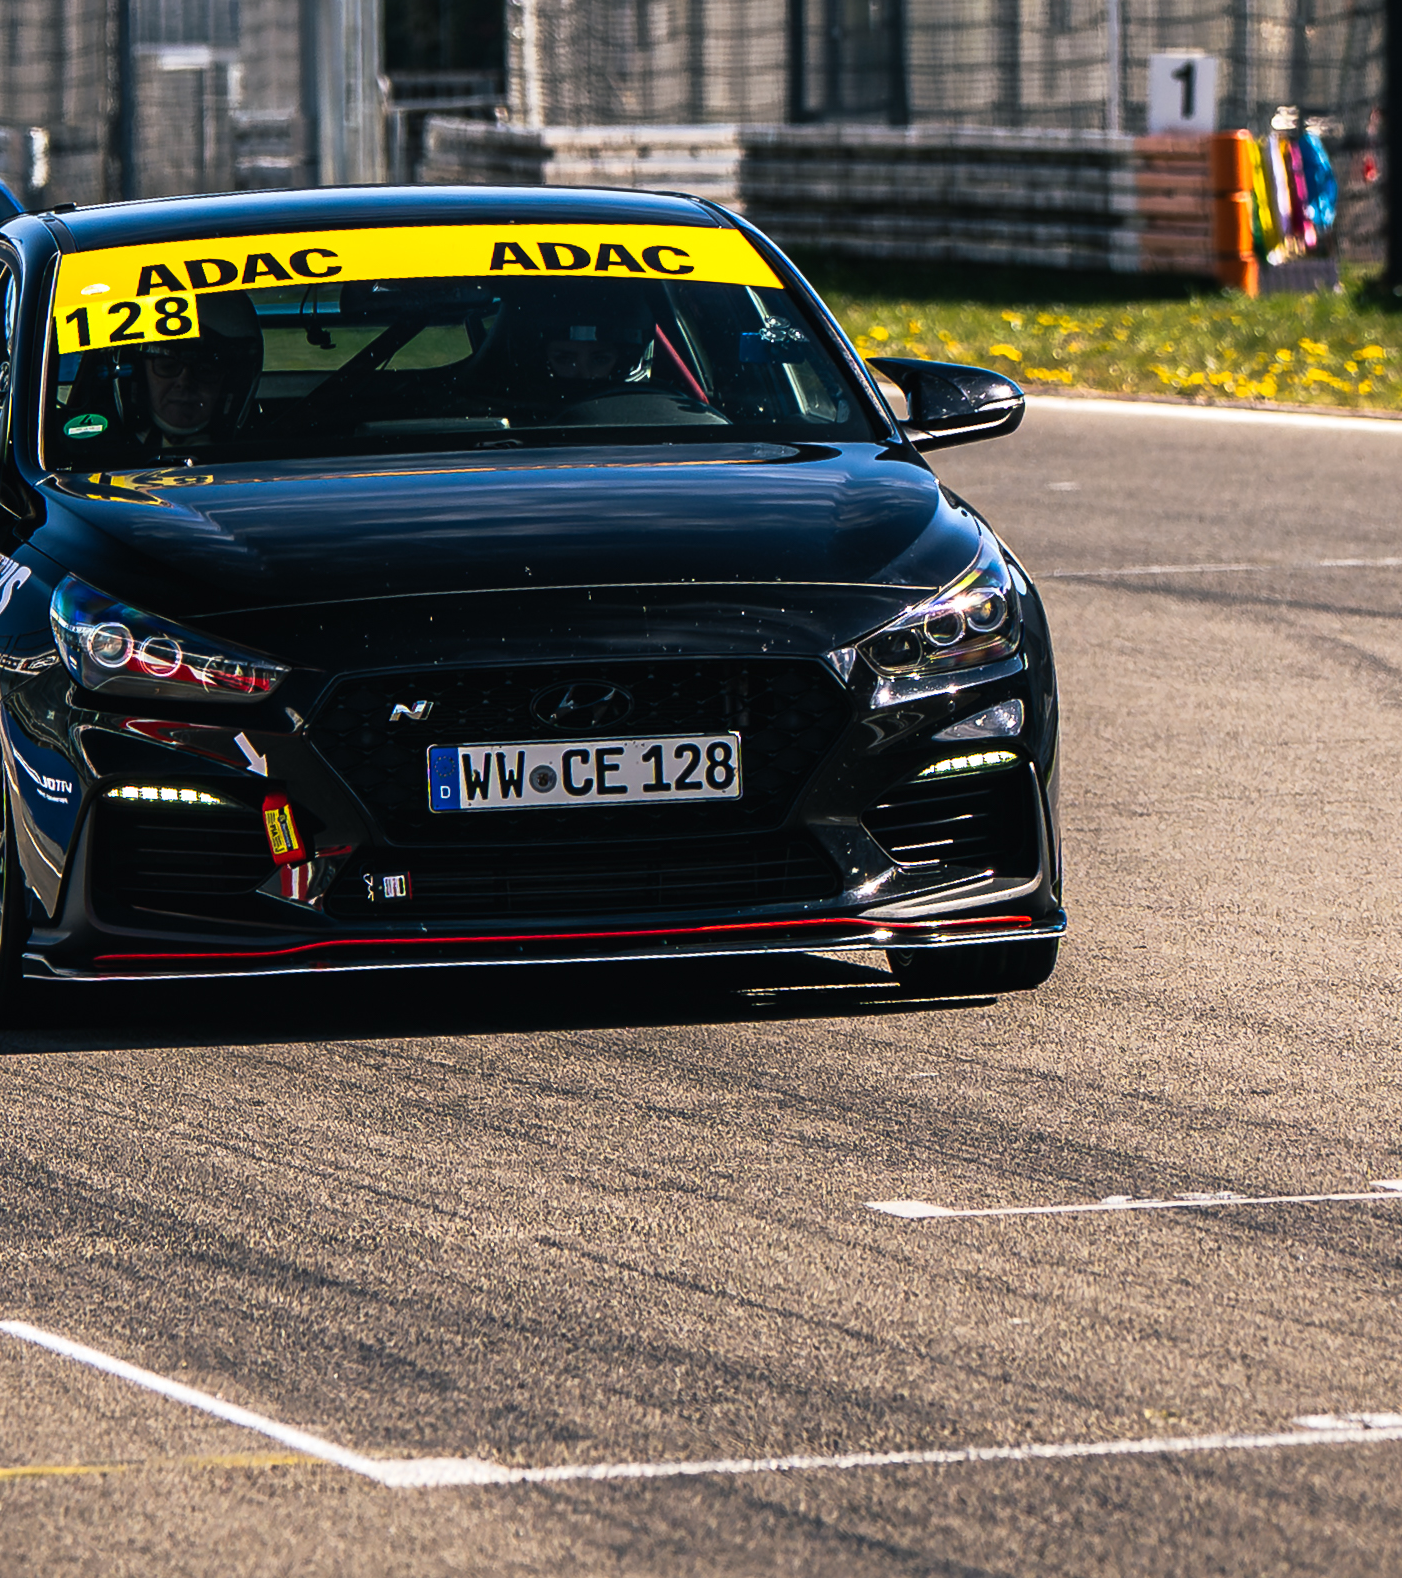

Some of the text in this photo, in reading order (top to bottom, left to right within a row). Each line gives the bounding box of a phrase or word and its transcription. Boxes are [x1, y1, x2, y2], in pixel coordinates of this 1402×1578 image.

[1171, 58, 1197, 121] 1
[135, 241, 695, 297] ADAC ADAC
[66, 296, 193, 348] 128
[439, 785, 451, 799] D
[461, 740, 735, 801] WW CE 128
